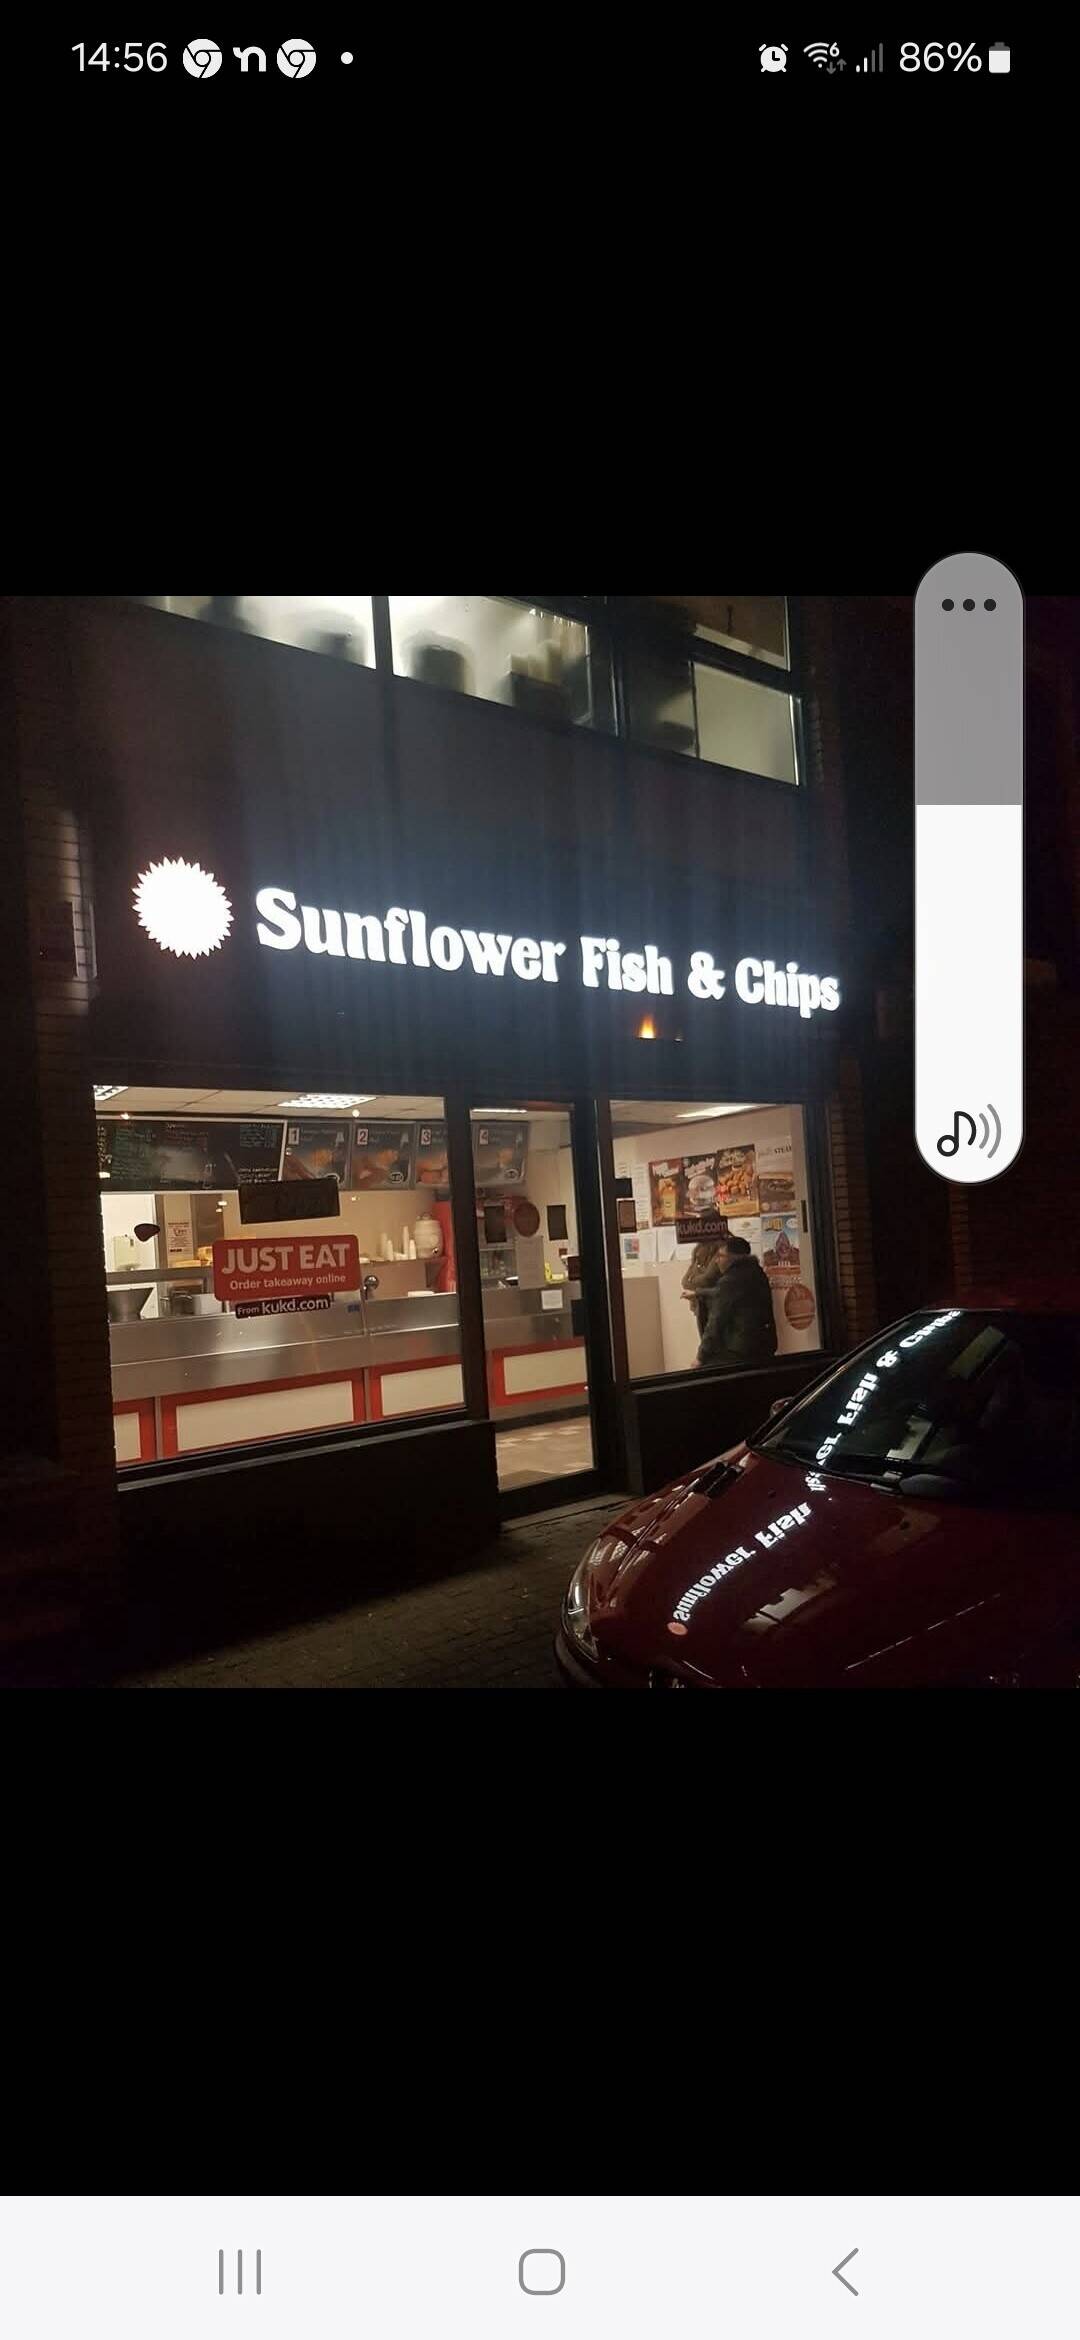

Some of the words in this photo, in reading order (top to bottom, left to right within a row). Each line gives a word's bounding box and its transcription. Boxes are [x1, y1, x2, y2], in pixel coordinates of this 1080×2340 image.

[256, 887, 567, 983] Sunflower
[580, 935, 674, 996] Fish
[687, 950, 726, 1000] &
[734, 957, 841, 1019] Chips
[358, 1130, 367, 1144] 2
[221, 1246, 294, 1275] JUST
[299, 1243, 350, 1270] EAT
[229, 1279, 261, 1290] Order
[263, 1276, 314, 1288] takeaway
[316, 1273, 346, 1284] online
[237, 1305, 260, 1316] From
[261, 1297, 329, 1315] kukd.com
